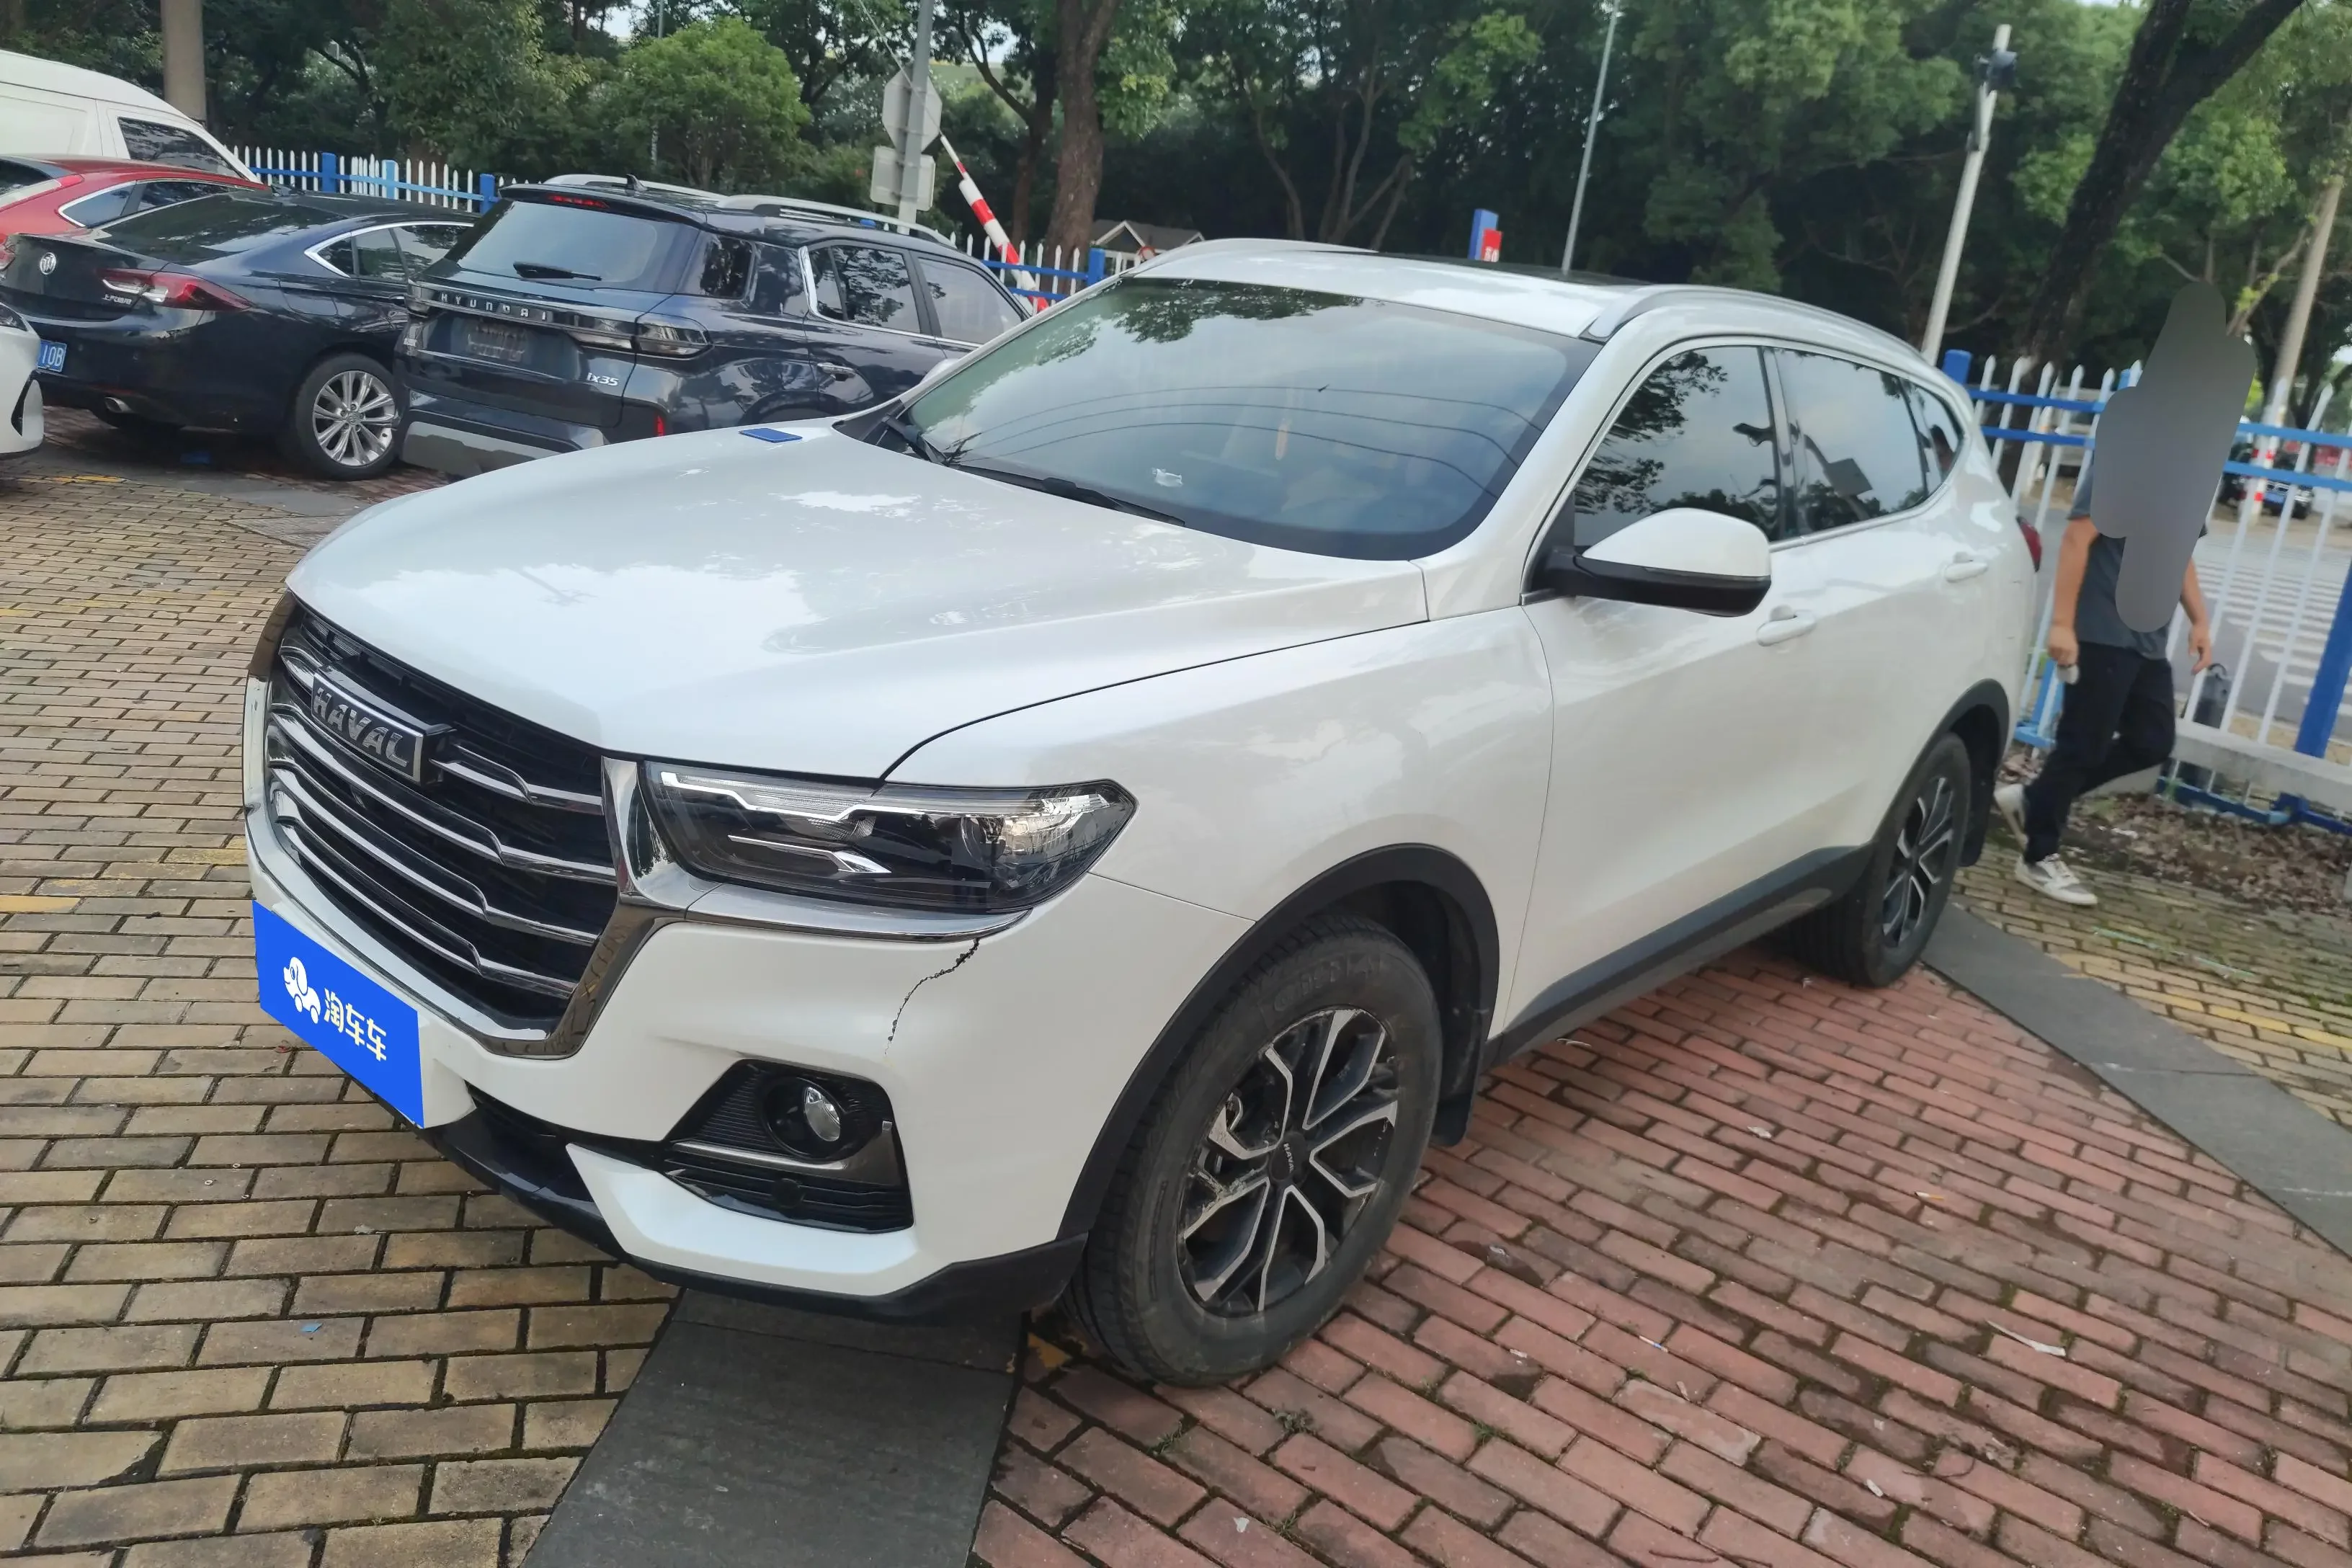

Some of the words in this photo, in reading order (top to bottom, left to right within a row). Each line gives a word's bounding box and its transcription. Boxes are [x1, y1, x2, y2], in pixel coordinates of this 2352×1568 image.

[440, 293, 547, 321] HYUNDAI
[586, 372, 619, 386] ix35
[313, 686, 409, 767] HAVAL
